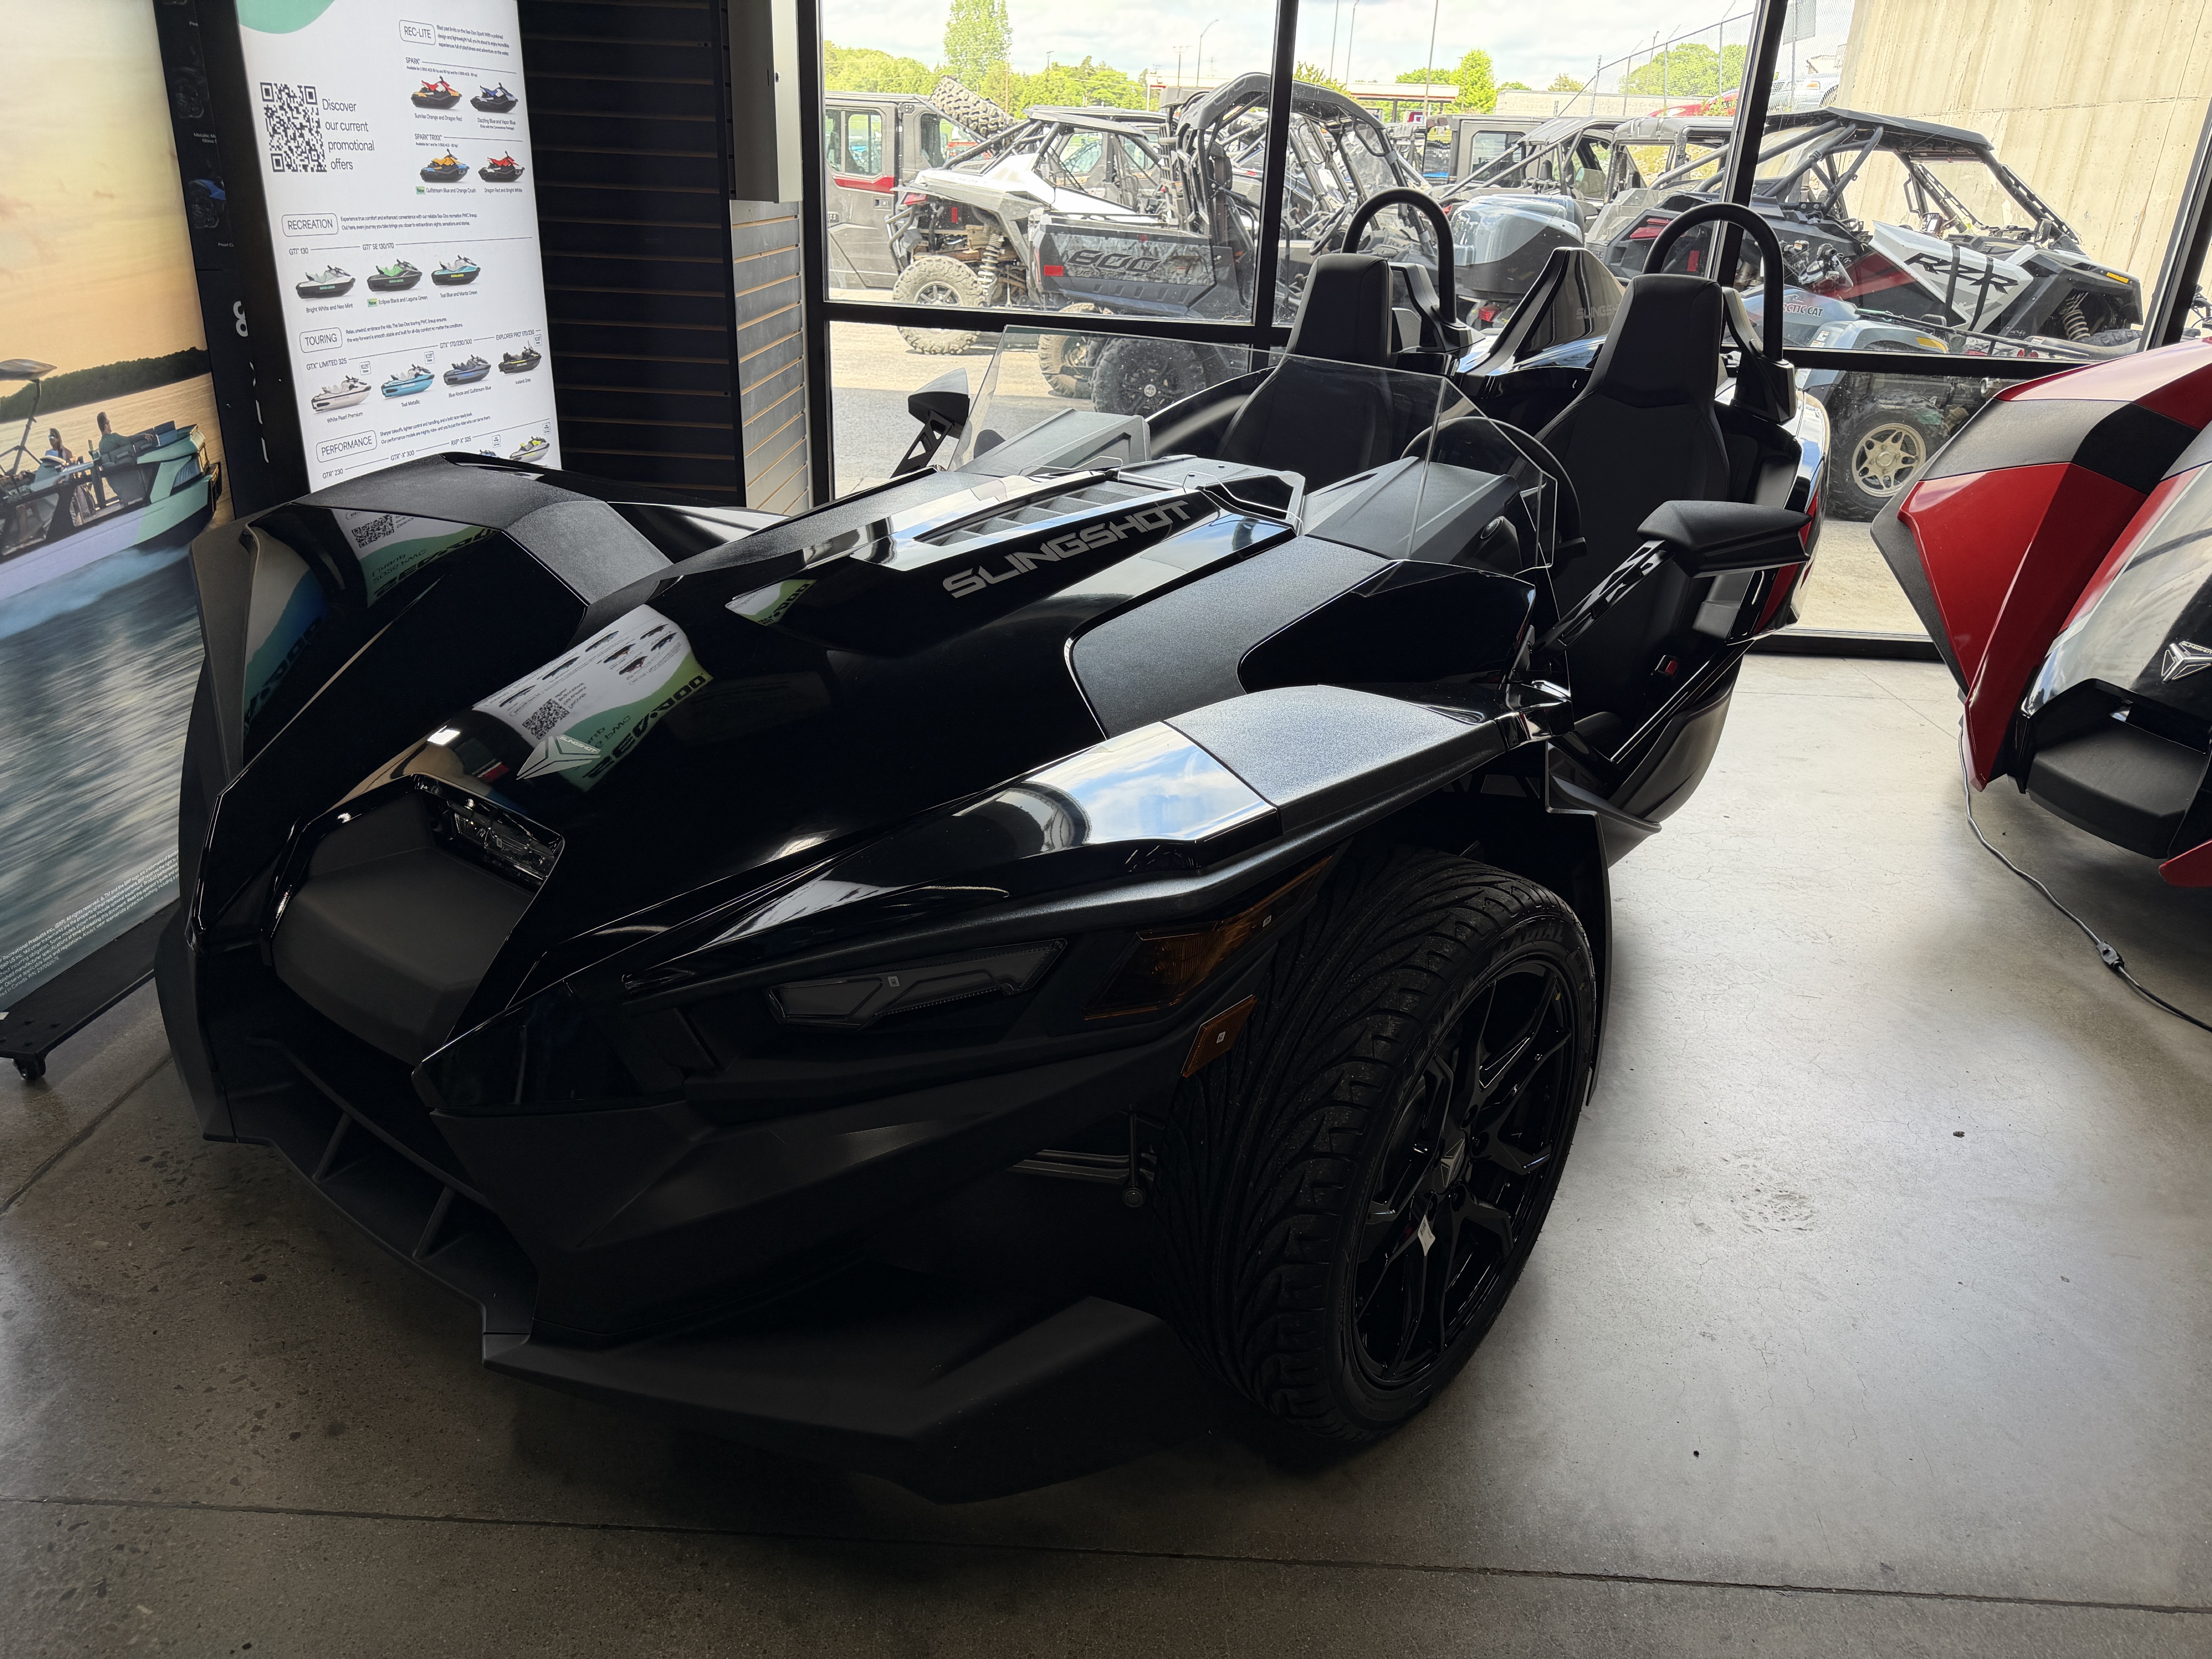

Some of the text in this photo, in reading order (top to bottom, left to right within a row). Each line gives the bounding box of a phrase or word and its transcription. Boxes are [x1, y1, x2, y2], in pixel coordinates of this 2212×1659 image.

[404, 26, 431, 39] REC-LITE
[322, 99, 356, 112] Discover
[325, 122, 368, 132] our current
[328, 139, 374, 153] promotional
[331, 158, 353, 170] offers
[288, 219, 333, 230] RECREATION
[1576, 304, 1619, 320] SLINGSH
[1783, 302, 1824, 319] RCTIC CAT
[305, 333, 337, 346] TOURING
[322, 436, 372, 456] PERFORMANCE
[942, 500, 1189, 598] SLINGSHOT
[559, 736, 597, 753] SLINGSHOT
